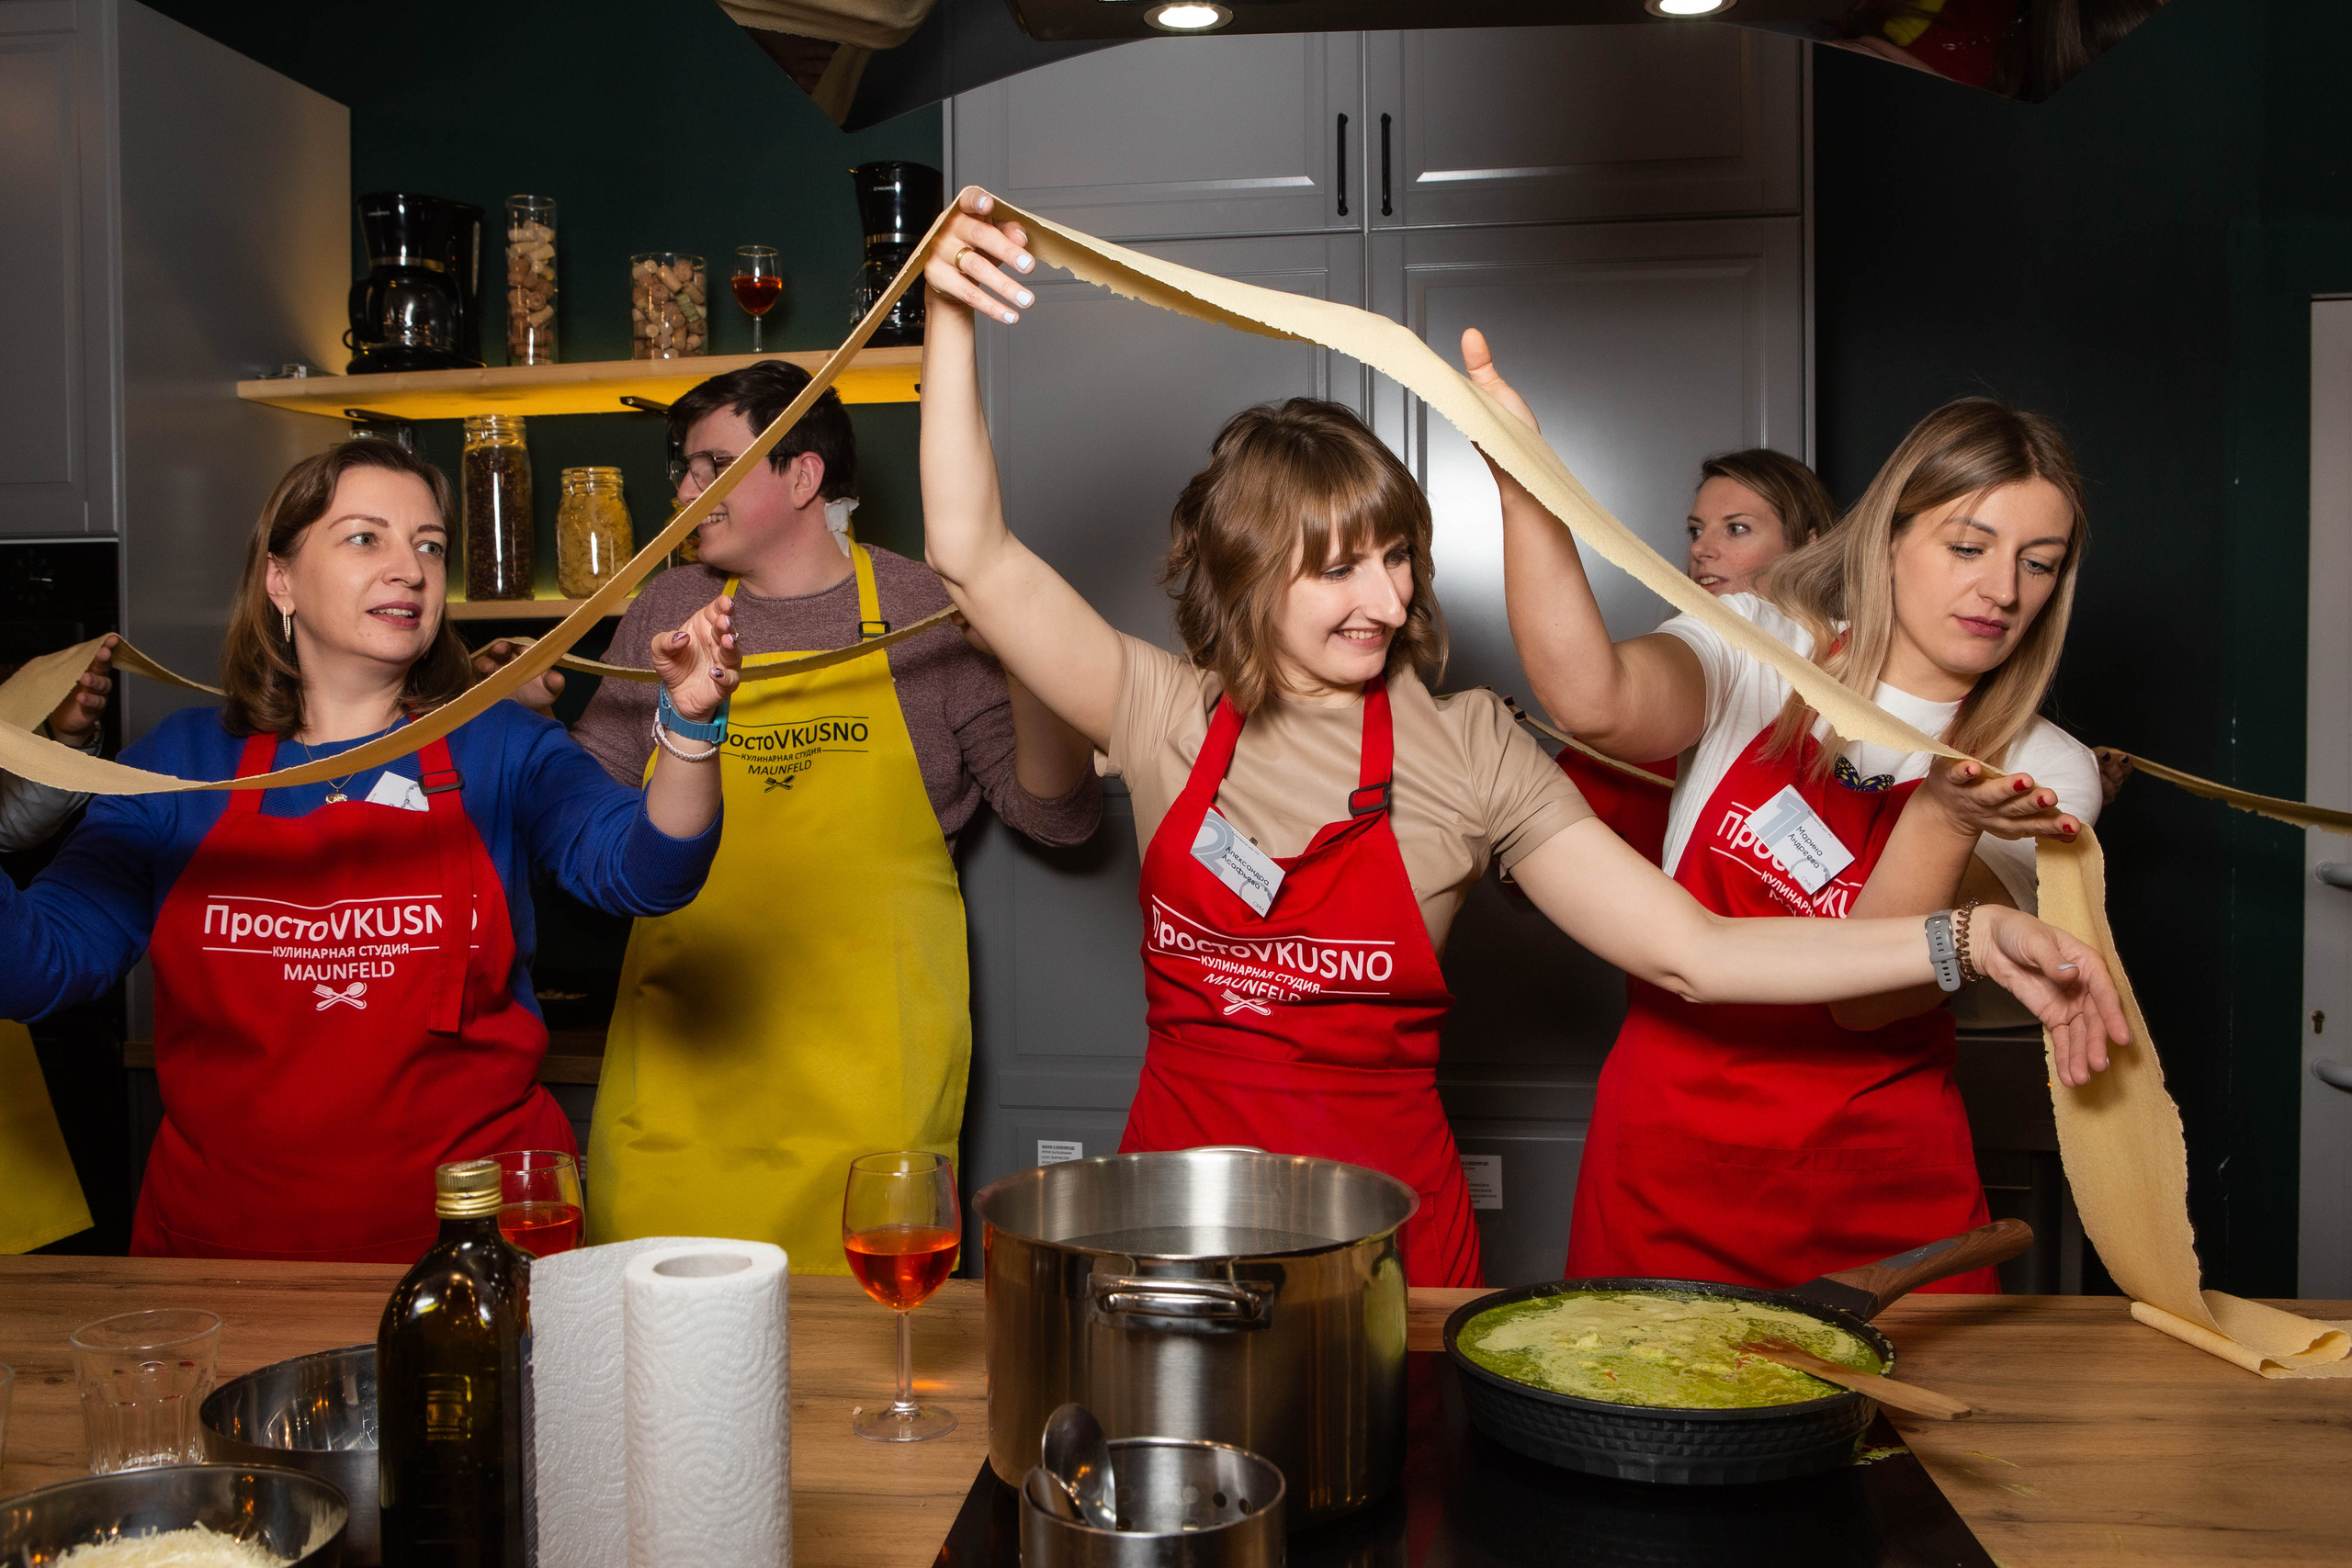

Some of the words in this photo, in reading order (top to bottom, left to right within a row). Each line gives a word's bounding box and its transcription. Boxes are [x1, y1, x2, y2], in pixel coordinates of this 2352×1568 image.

[724, 722, 868, 751] остоVKUSNO
[741, 753, 794, 763] КУЛИНАРНАЯ
[795, 747, 822, 761] СТУДИЯ
[748, 760, 812, 776] MAUNFELD
[1788, 833, 1820, 869] Андреева
[1796, 826, 1823, 857] Марина
[1222, 854, 1261, 890] Асафьева
[1226, 846, 1270, 886] Александра
[203, 904, 477, 942] ПростоVKUSN
[272, 946, 356, 959] КУЛИНАРНАЯ
[358, 942, 410, 957] СТУДИЯ
[283, 961, 395, 981] MAUNFELD
[1201, 955, 1275, 979] КУЛИНАРНАЯ
[1274, 973, 1321, 994] СТУДИЯ
[1203, 973, 1302, 1002] MAUNFELD
